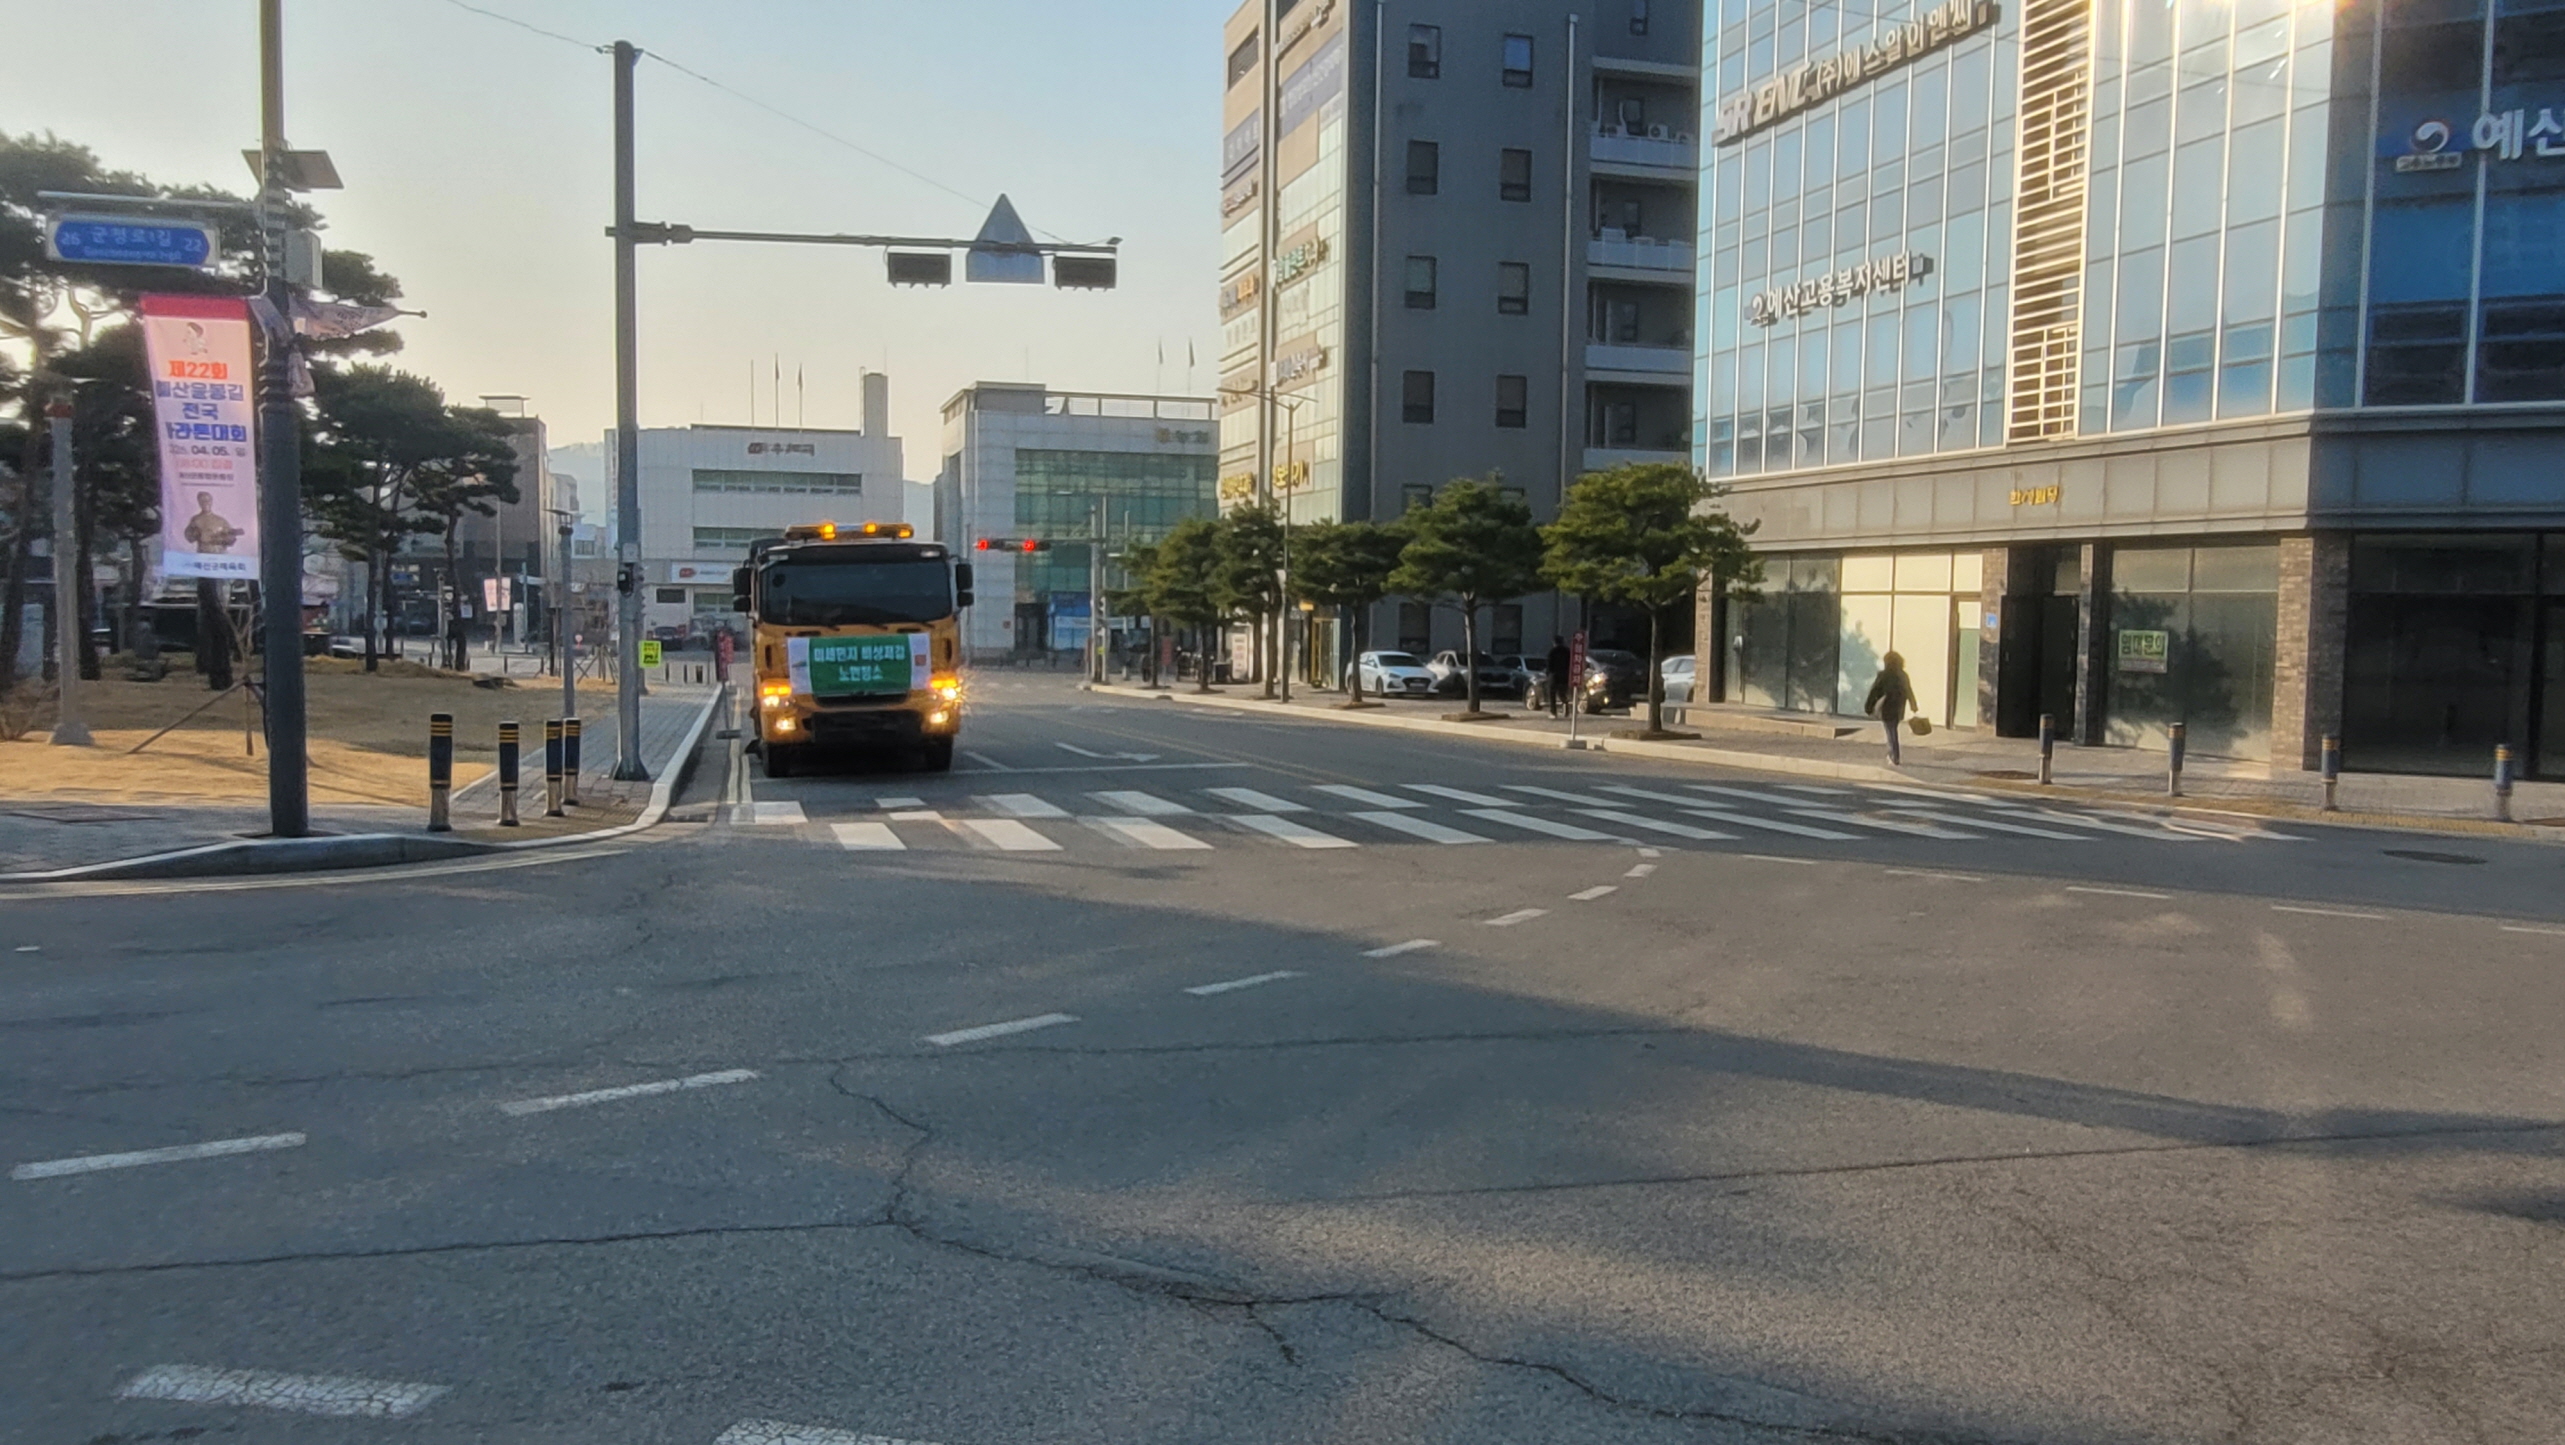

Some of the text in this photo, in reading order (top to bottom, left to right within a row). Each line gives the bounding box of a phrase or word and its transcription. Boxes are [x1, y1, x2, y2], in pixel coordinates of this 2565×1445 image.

[1766, 249, 1911, 319] 예산고용복지센터
[168, 360, 228, 380] 제22회
[182, 402, 219, 420] 전국
[813, 646, 858, 662] 미세먼지
[2121, 633, 2166, 656] 임대문의
